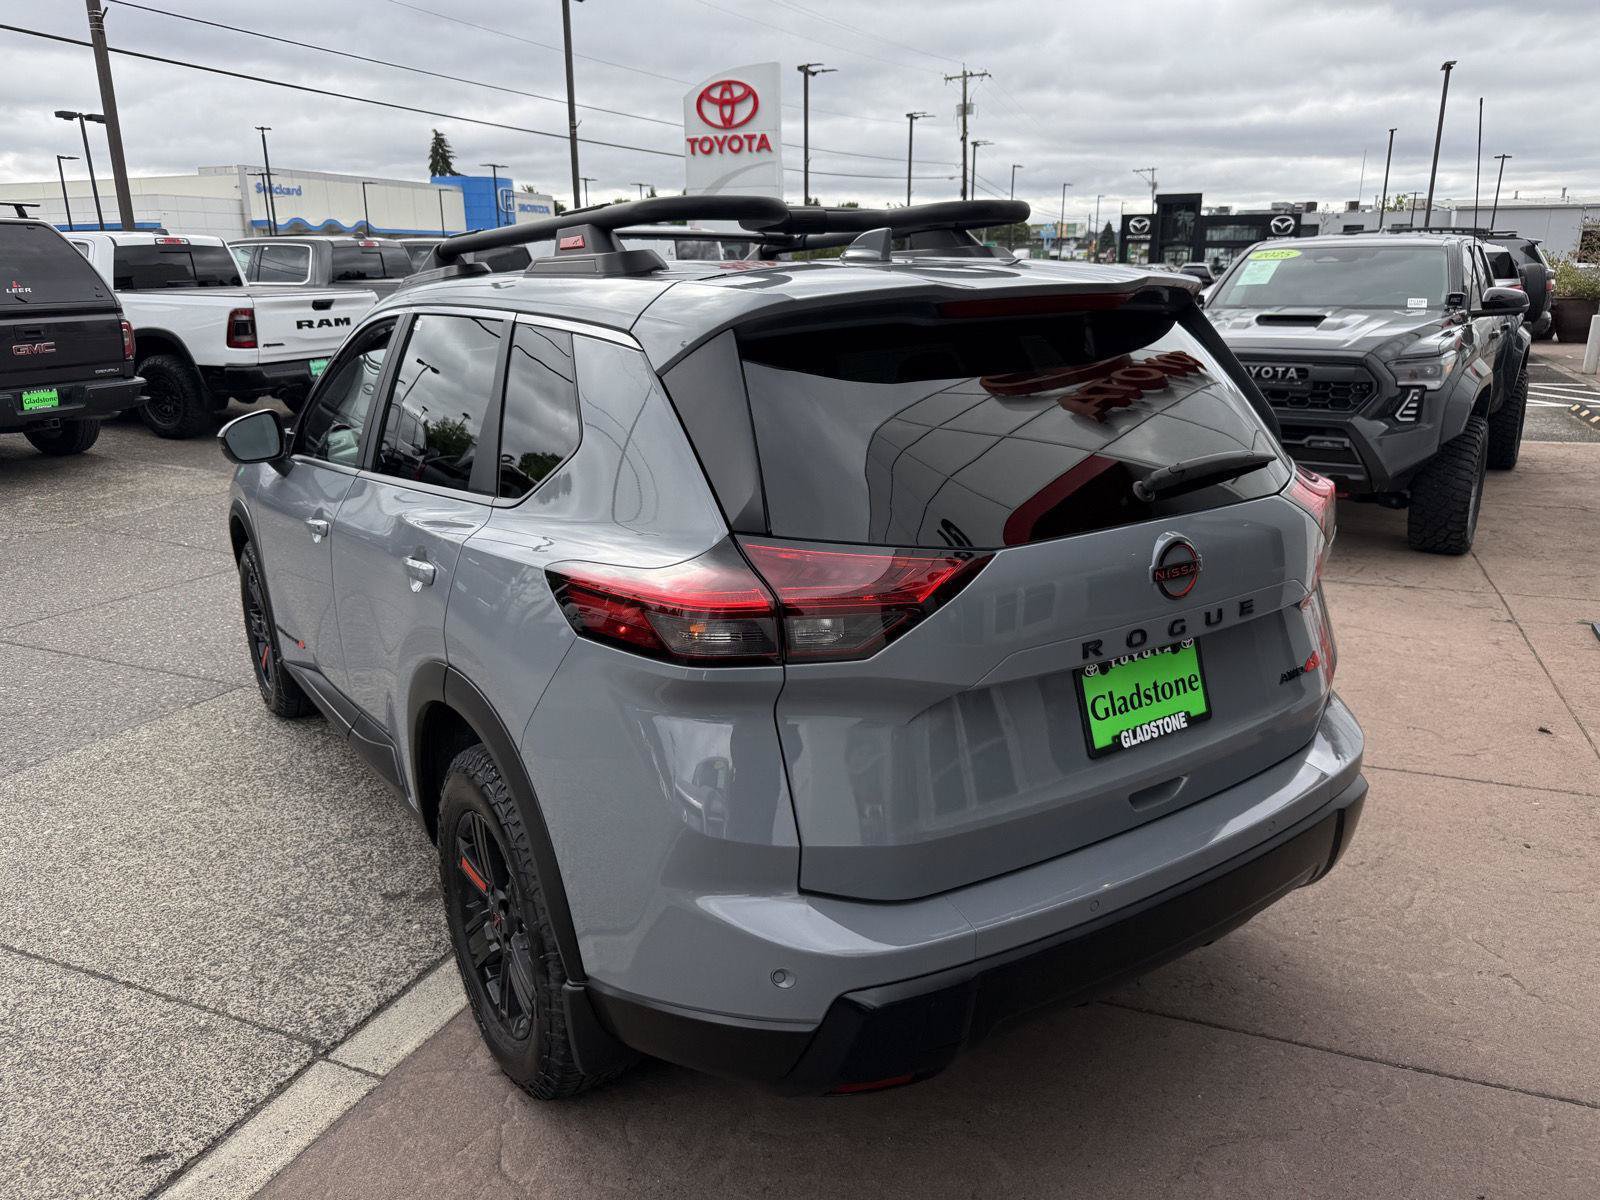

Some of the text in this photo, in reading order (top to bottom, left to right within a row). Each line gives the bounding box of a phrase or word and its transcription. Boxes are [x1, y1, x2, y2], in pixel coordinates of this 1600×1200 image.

[686, 133, 773, 156] TOYOTA
[296, 317, 351, 330] RAM
[12, 341, 57, 356] GMC
[1248, 366, 1298, 379] YOTA
[1082, 599, 1255, 660] ROGUE
[1090, 673, 1199, 721] Gladstone
[1120, 711, 1188, 749] GLADSTONE
